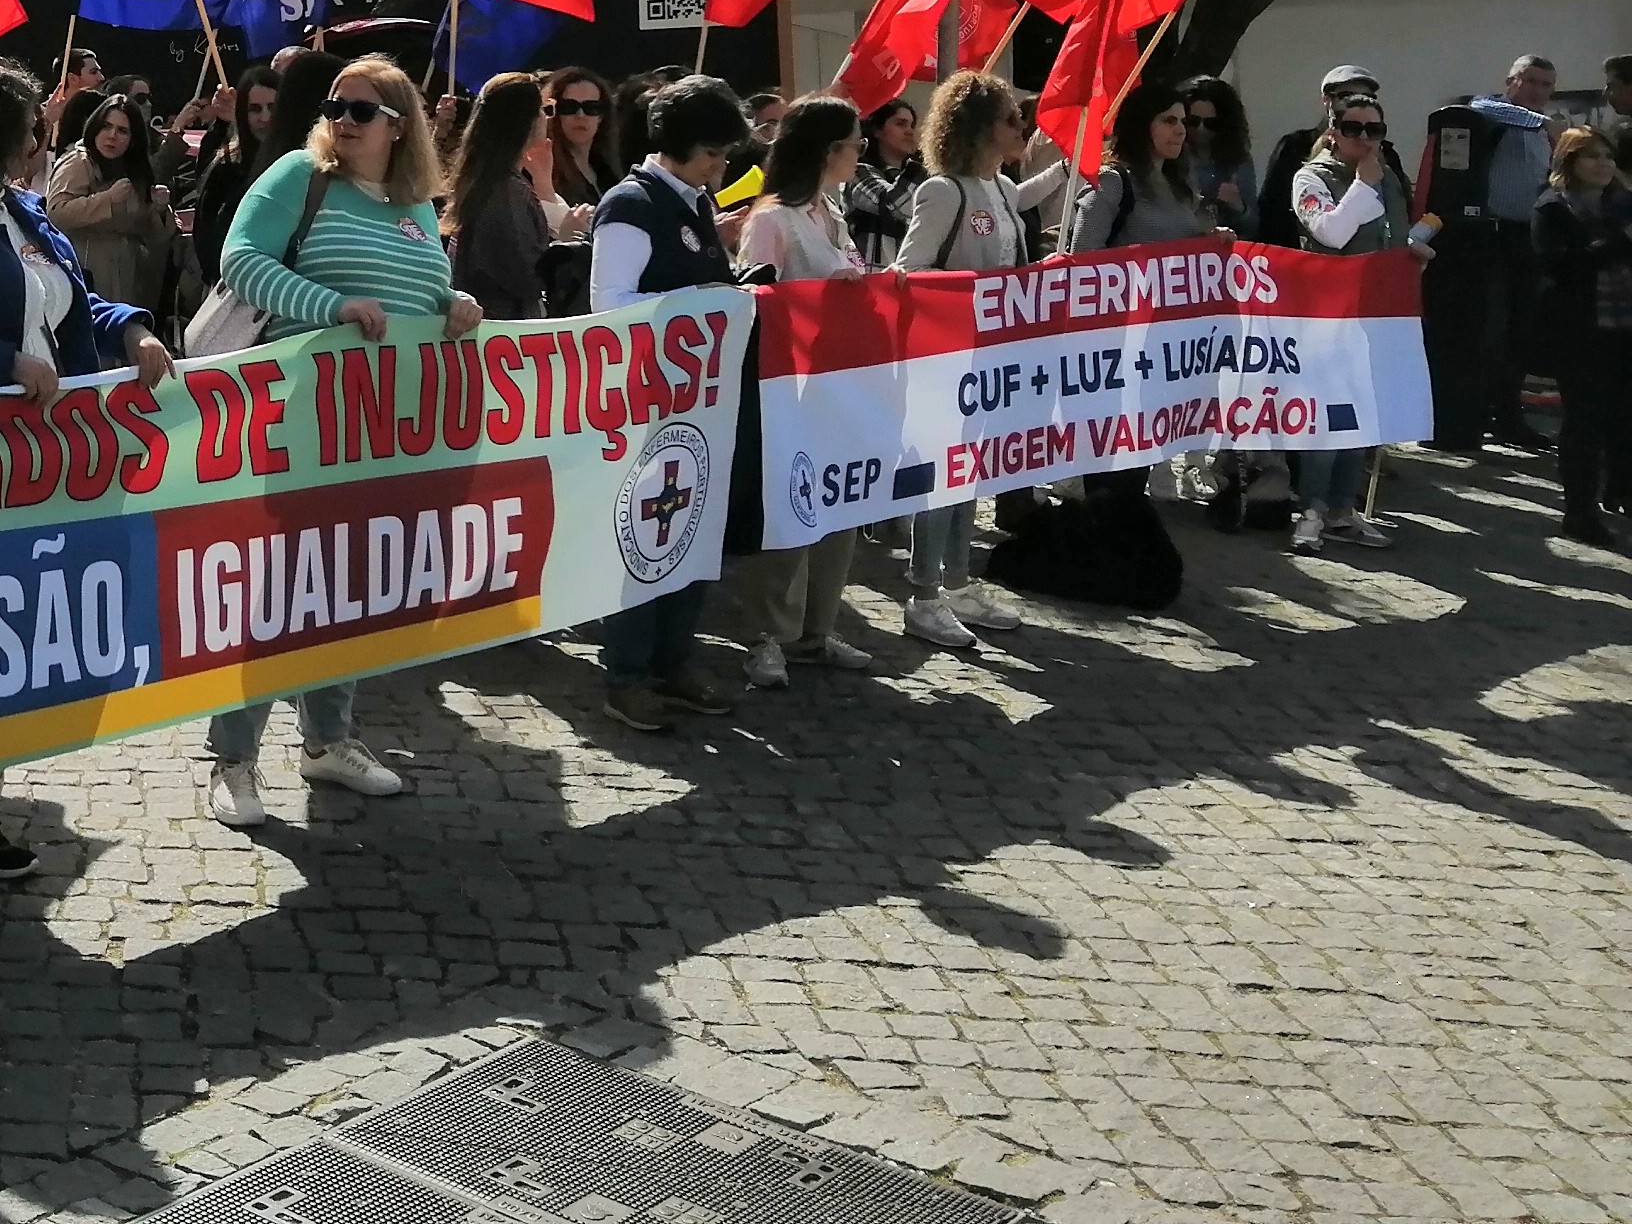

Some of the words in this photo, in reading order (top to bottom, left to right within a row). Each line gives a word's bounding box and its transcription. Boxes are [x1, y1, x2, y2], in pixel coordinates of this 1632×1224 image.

[169, 41, 185, 64] by
[973, 254, 1278, 333] ENFERMEIROS
[195, 359, 291, 484] DE
[313, 310, 729, 463] INJUSTIÇAS!
[957, 363, 1021, 418] CUF
[1030, 370, 1049, 397] +
[1060, 346, 1125, 398] LUZ
[1134, 353, 1155, 380] +
[1163, 326, 1301, 383] LUSÍADAS
[637, 429, 706, 470] ENFERMEIROS
[945, 418, 1077, 490] EXIGEM
[1088, 384, 1318, 459] VALORIZAÇÃO!
[619, 469, 638, 504] DOS
[668, 457, 708, 566] PORTUGUESES
[821, 457, 882, 507] SEP
[174, 496, 524, 660] IGUALDADE
[618, 510, 649, 577] SINDICATO
